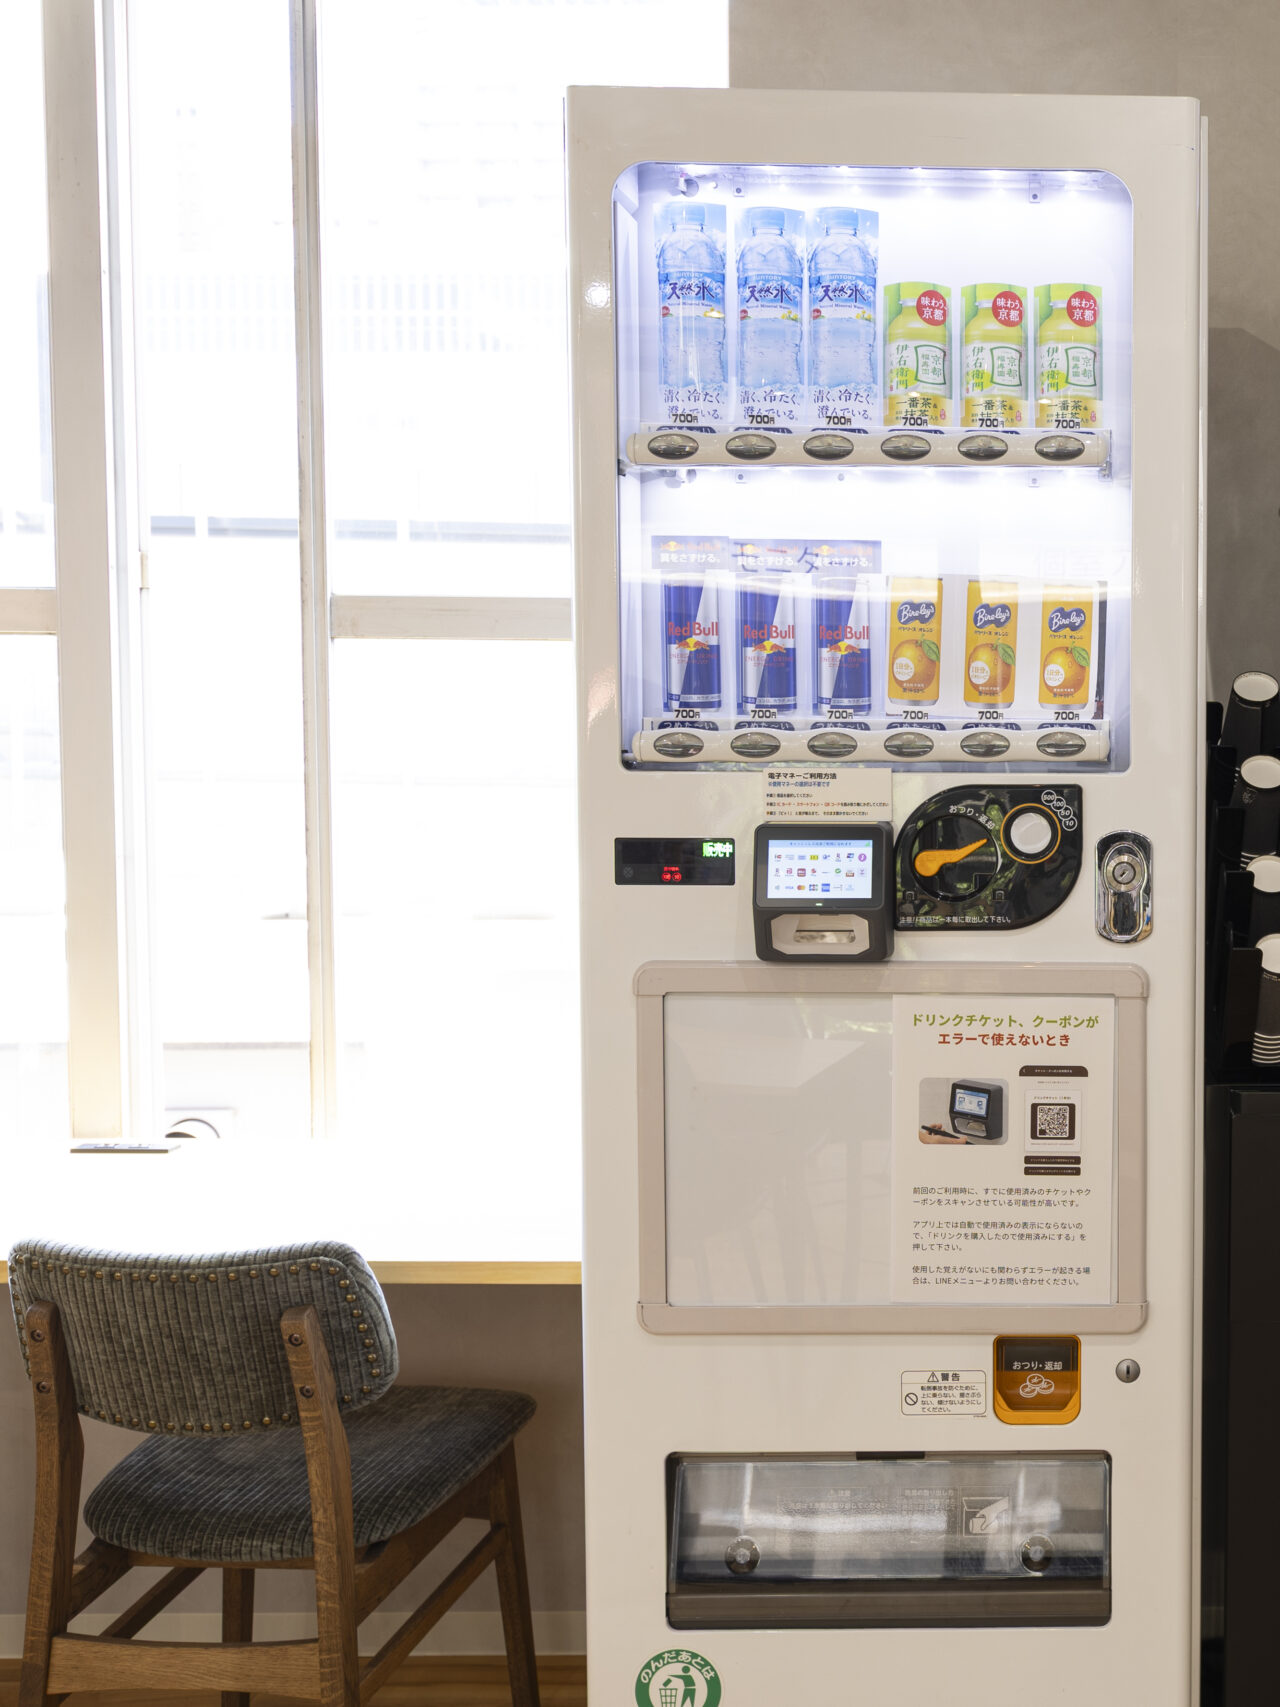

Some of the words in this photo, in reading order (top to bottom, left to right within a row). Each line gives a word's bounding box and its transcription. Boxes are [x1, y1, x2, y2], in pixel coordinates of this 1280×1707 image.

[667, 282, 715, 301] 天然水
[746, 284, 793, 303] 天然水
[819, 284, 867, 303] 天然水
[922, 308, 944, 320] 京都
[998, 309, 1020, 321] 京都
[1072, 309, 1094, 321] 京都
[896, 344, 910, 390] 伊右衛門
[972, 346, 986, 391] 伊右衛門
[1046, 346, 1060, 392] 伊右衛門
[672, 414, 698, 423] 700円
[749, 414, 775, 424] 700円
[825, 415, 852, 425] 700円
[902, 416, 928, 427] 700円
[978, 418, 1004, 428] 700円
[1054, 418, 1080, 429] 700円
[668, 622, 690, 636] Red
[693, 622, 719, 636] Bull
[744, 624, 767, 639] Red
[770, 624, 795, 639] Bull
[819, 625, 842, 640] Red
[845, 625, 869, 640] Bull
[674, 709, 700, 719] 700円
[750, 710, 777, 719] 700円
[827, 710, 853, 719] 700円
[902, 711, 928, 720] 700円
[978, 711, 1004, 720] 700円
[1054, 711, 1080, 721] 700円
[768, 772, 837, 780] 電子マネーご利用方法
[913, 1013, 1099, 1029] ドリンクチケット、クーポンが
[938, 1033, 1070, 1047] エラーで使えないとき
[912, 1186, 1091, 1196] 前回のご利用時に、すでに使用済みのチケットやク
[912, 1220, 1083, 1230] アプリ上では自動で使用済みの表示にならないの
[912, 1243, 962, 1252] 押して下さい。
[1012, 1361, 1063, 1371] おつり・返却
[941, 1372, 960, 1382] 警告
[641, 1651, 715, 1683] のんだあとは
